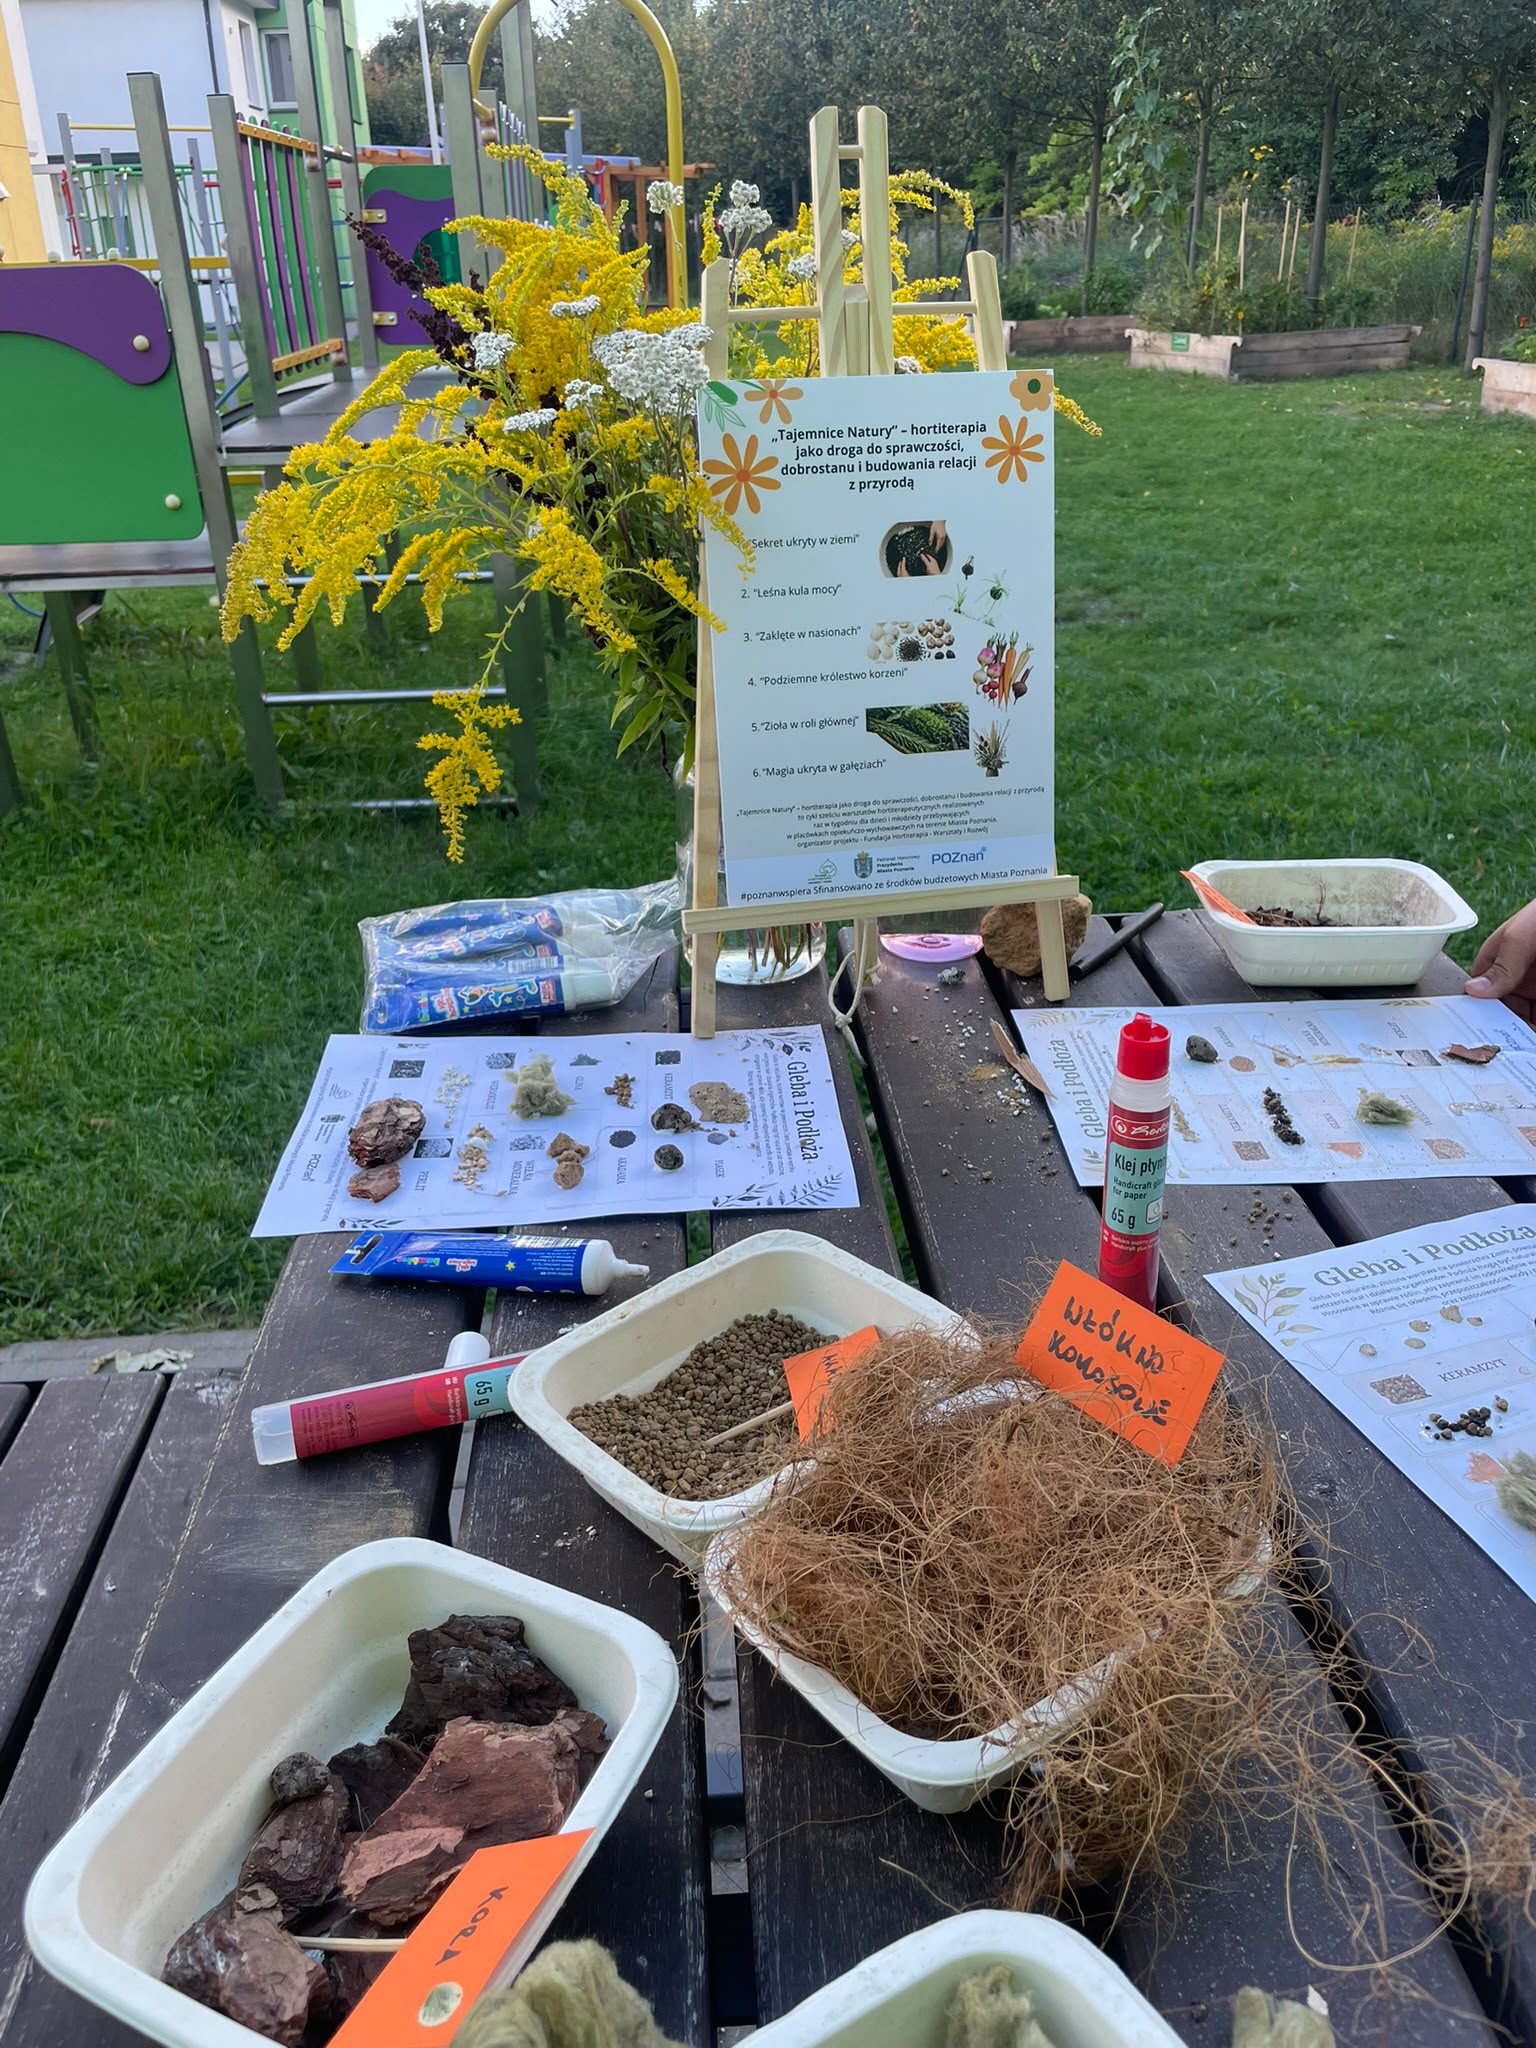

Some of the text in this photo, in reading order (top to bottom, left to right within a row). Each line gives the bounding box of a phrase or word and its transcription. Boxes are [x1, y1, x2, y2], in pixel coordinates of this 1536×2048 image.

[771, 427, 843, 443] „Tajemnice
[911, 421, 986, 436] hortiterapia
[795, 439, 963, 460] jako droga do sprawczości,
[781, 463, 854, 475] dobrostanu
[865, 457, 934, 472] budowania
[938, 455, 976, 470] relacji
[849, 476, 913, 492] z przyrodą
[785, 536, 817, 549] ukryty
[741, 588, 749, 598] 2.
[788, 585, 809, 598] kula
[743, 632, 752, 642] 3.
[747, 677, 756, 685] 4.
[820, 671, 866, 684] królestwo
[800, 716, 816, 732] roli
[797, 764, 827, 775] ukryta
[801, 802, 837, 811] hortiterapia
[838, 801, 852, 809] jako
[882, 795, 919, 806] sprawczości,
[920, 793, 955, 801] dobrostanu
[959, 790, 993, 798] budowania
[994, 788, 1012, 796] relacji
[1017, 786, 1044, 795] przyrodą
[805, 812, 817, 820] cykl
[818, 810, 840, 818] sześciu
[841, 808, 876, 816] warsztatów
[877, 803, 941, 814] hortiterapeutycznych
[942, 799, 984, 809] realizowanych
[830, 818, 857, 828] tygodniu
[891, 813, 921, 821] młodzieży
[922, 809, 969, 820] przebywających
[793, 829, 829, 839] placówkach
[829, 822, 915, 836] opiekuńczo-wychowawczych
[947, 818, 967, 826] Miasta
[797, 826, 988, 848] organizator projektu Fundacja Hortiterapia Warsztaty Rozwój
[740, 888, 811, 902] #poznanwspiera
[813, 883, 872, 894] Sfinansowano
[885, 877, 921, 888] środków
[924, 871, 978, 884] budżetowych
[980, 869, 1007, 879] Miasta
[1009, 866, 1047, 877] Poznania
[1047, 1039, 1084, 1087] Podłoża
[787, 1061, 809, 1098] Gleba
[1075, 1099, 1106, 1138] Gleba
[794, 1109, 823, 1160] Podłoża
[1115, 1152, 1136, 1176] Klej
[1113, 1176, 1152, 1190] Handicraft
[1113, 1186, 1147, 1200] for paper
[1111, 1207, 1136, 1229] 65 g
[1314, 1225, 1536, 1286] Gleba i Podłoża
[1439, 1358, 1508, 1383] KERAMZYT
[474, 1381, 493, 1407] 65 g
[434, 1886, 509, 1967] KORA
